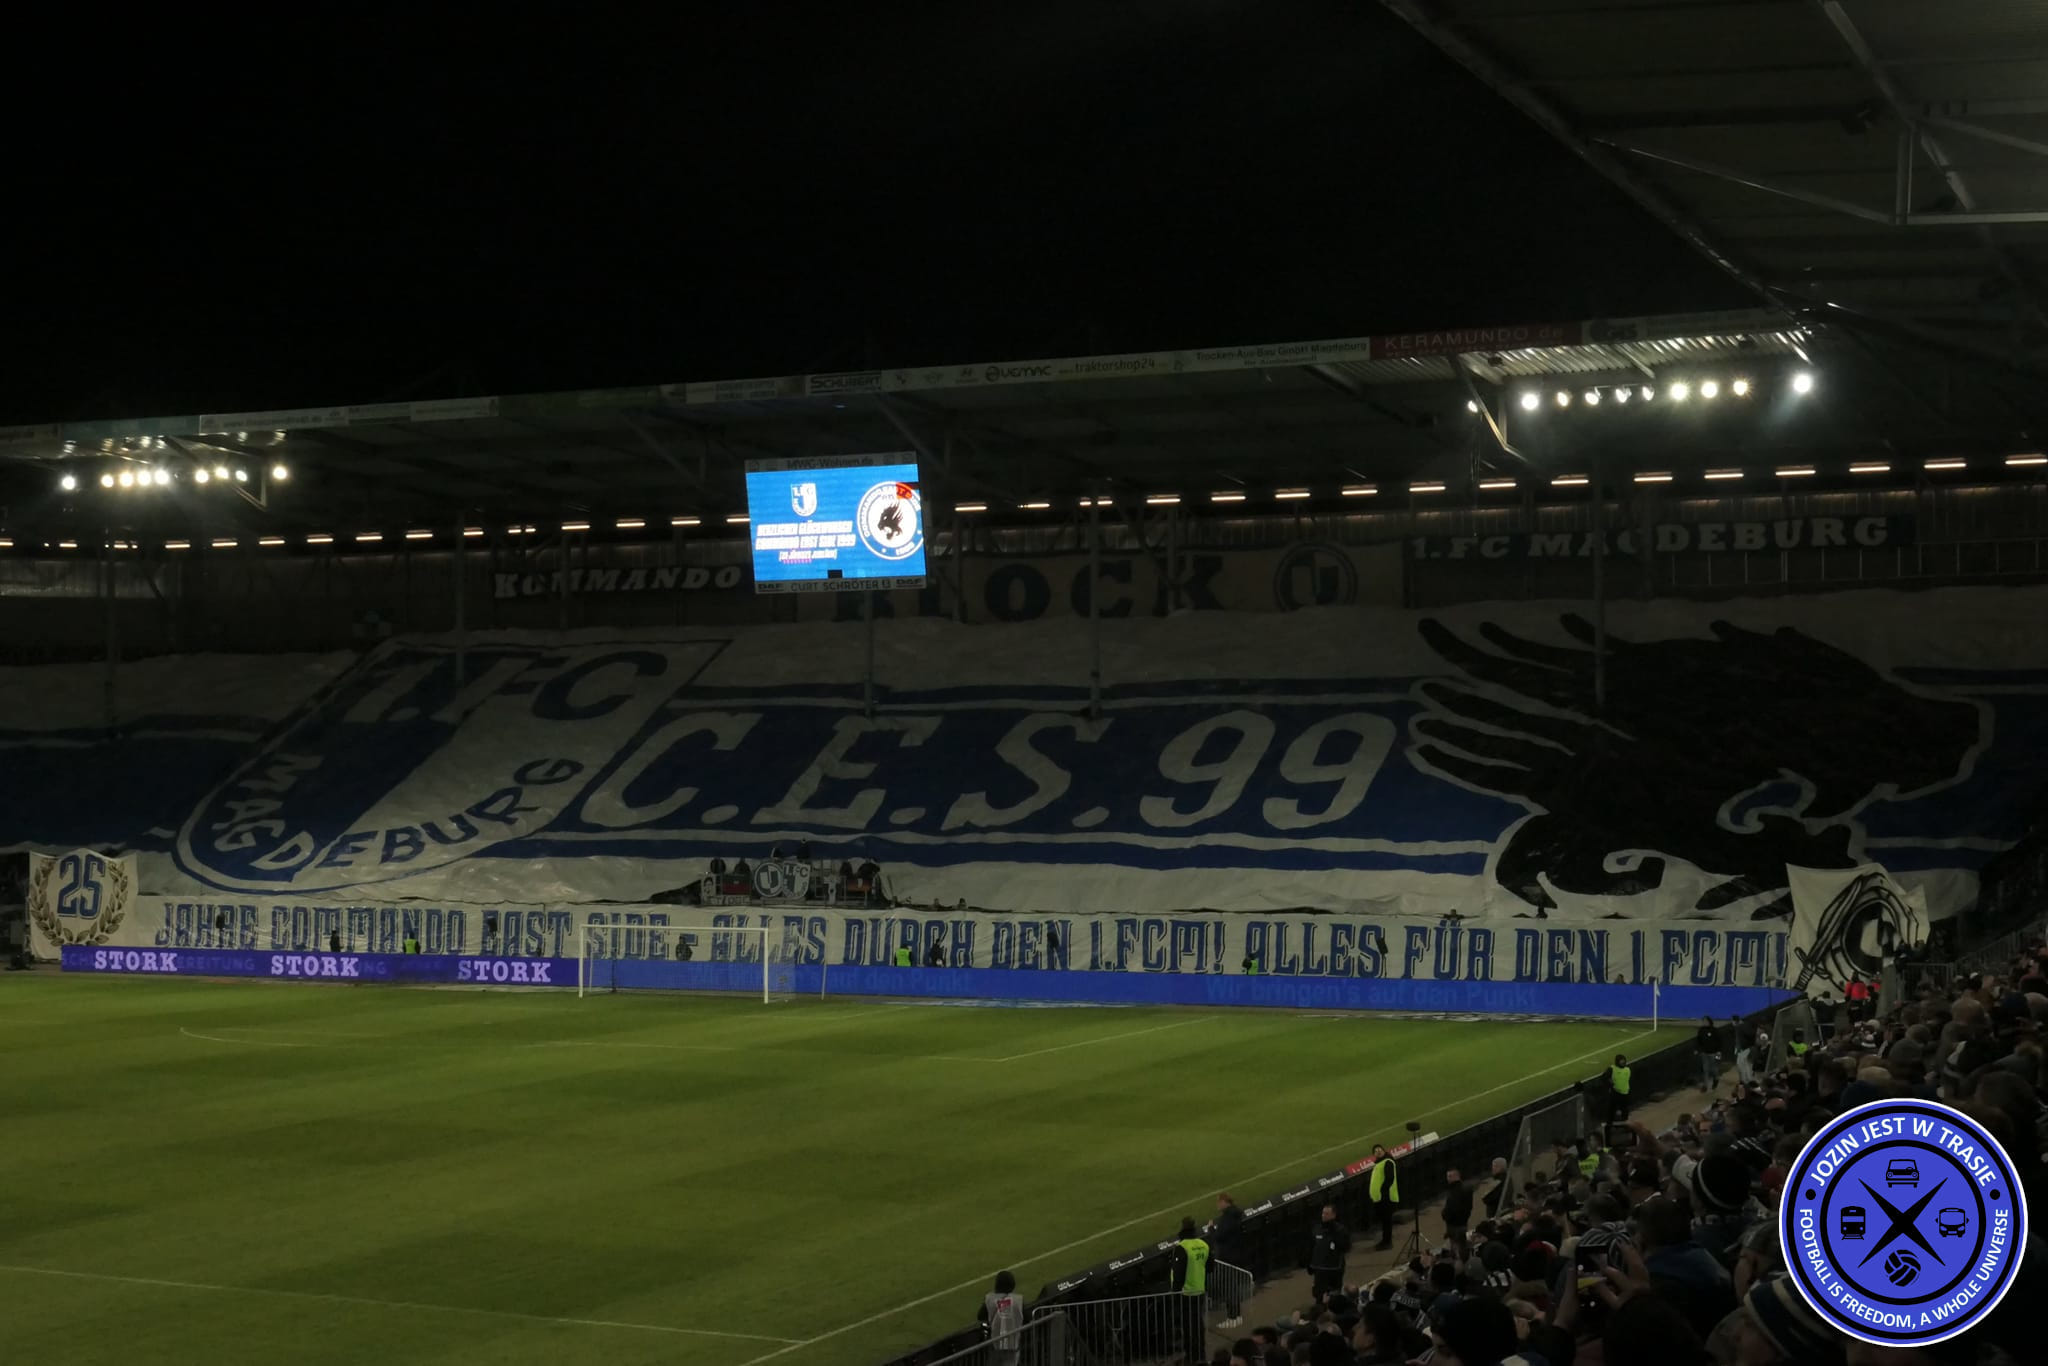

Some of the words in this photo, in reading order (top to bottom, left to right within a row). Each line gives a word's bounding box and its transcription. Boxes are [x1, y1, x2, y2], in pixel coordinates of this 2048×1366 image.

[211, 752, 584, 872] MAGDEBURG
[57, 853, 106, 919] 25
[155, 902, 258, 949] JAHRE
[271, 905, 467, 955] COMMANDO
[479, 909, 573, 958] EAST
[586, 912, 672, 961] SIDE
[711, 913, 828, 965] ALLES
[844, 916, 977, 969] DURCH
[991, 918, 1072, 971] DEN
[1245, 920, 1387, 978] ALLES
[1401, 919, 1496, 982] FÜR
[1511, 927, 1610, 984] DEN
[94, 950, 178, 972] STORK
[270, 954, 360, 977] STORK
[457, 960, 552, 983] STORK
[1467, 985, 1537, 1008] Punkt
